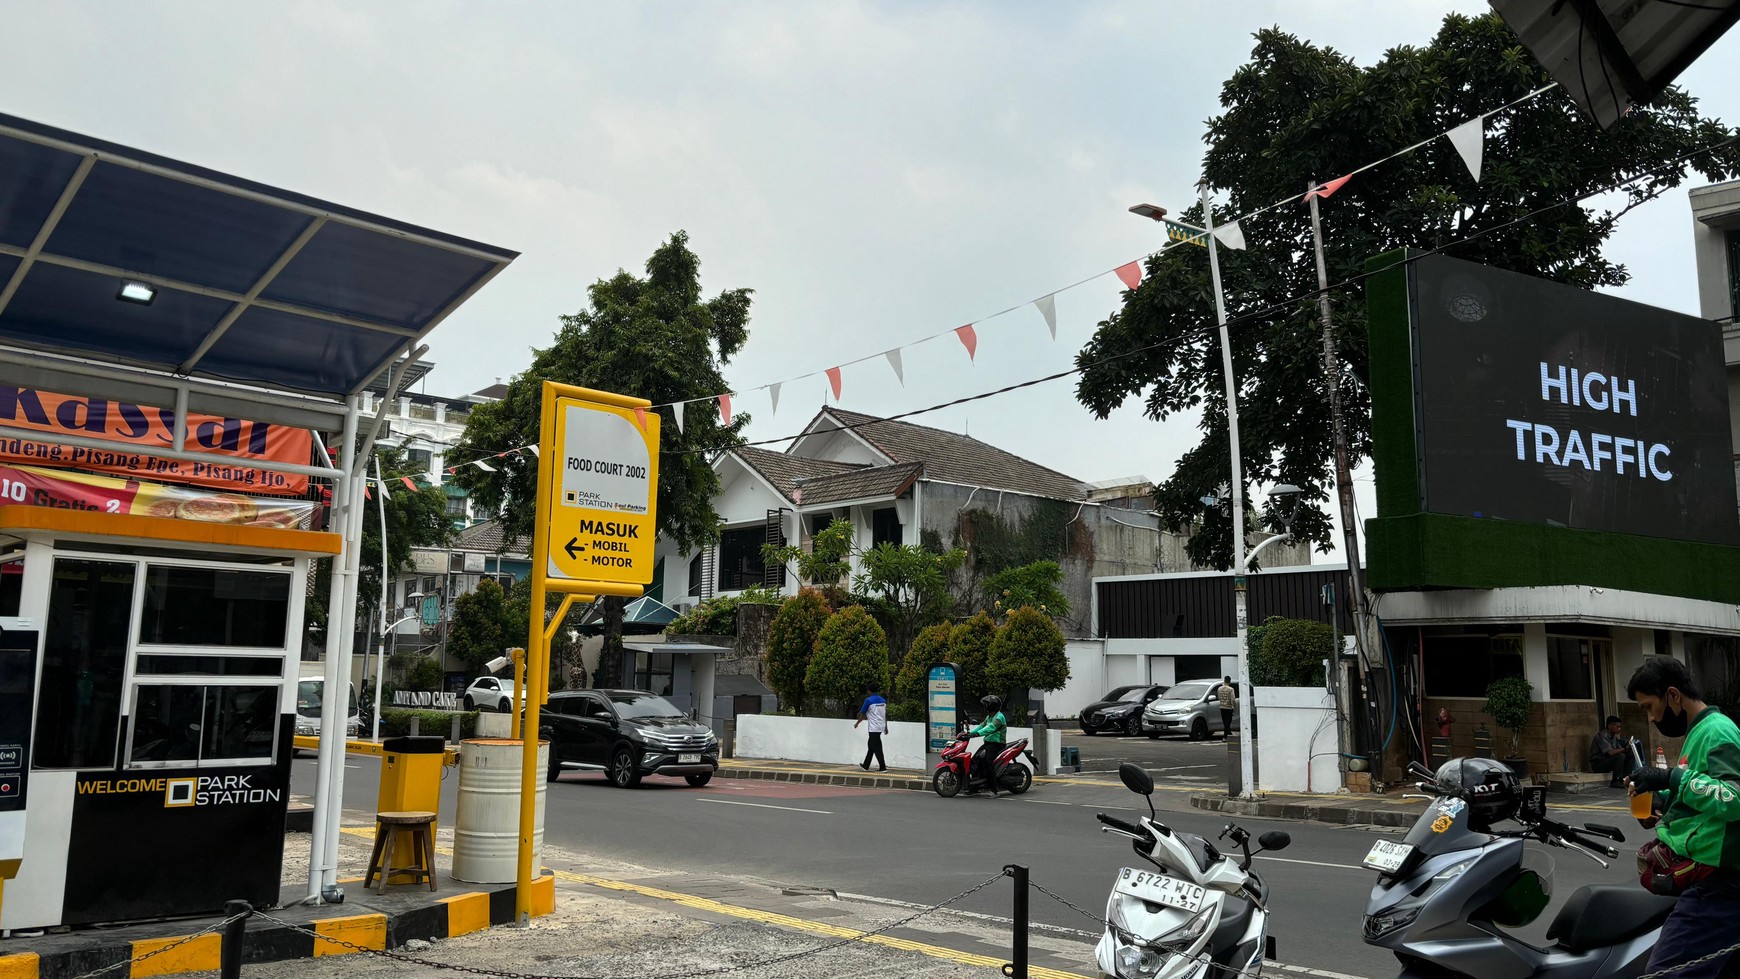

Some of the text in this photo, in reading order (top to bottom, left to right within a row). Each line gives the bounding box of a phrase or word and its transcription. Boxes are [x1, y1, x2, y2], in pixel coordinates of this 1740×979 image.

[1540, 362, 1637, 416] HIGH
[1506, 419, 1673, 481] TRAFFIC
[146, 457, 186, 475] Epe,
[193, 462, 255, 484] Pisang
[261, 471, 291, 489] Ijo,
[567, 457, 646, 479] FOOD COURT 2002
[1, 478, 27, 502] 10
[578, 491, 601, 500] PARK
[578, 498, 613, 508] STATION
[580, 519, 639, 538] MASUK
[592, 540, 630, 552] MOBIL
[591, 555, 633, 568] MOTOR
[77, 778, 167, 794] WELCOME
[197, 774, 252, 791] PARK
[1473, 782, 1500, 794] KYT
[196, 788, 281, 806] STATION
[1122, 868, 1202, 899] B 6722 WTC
